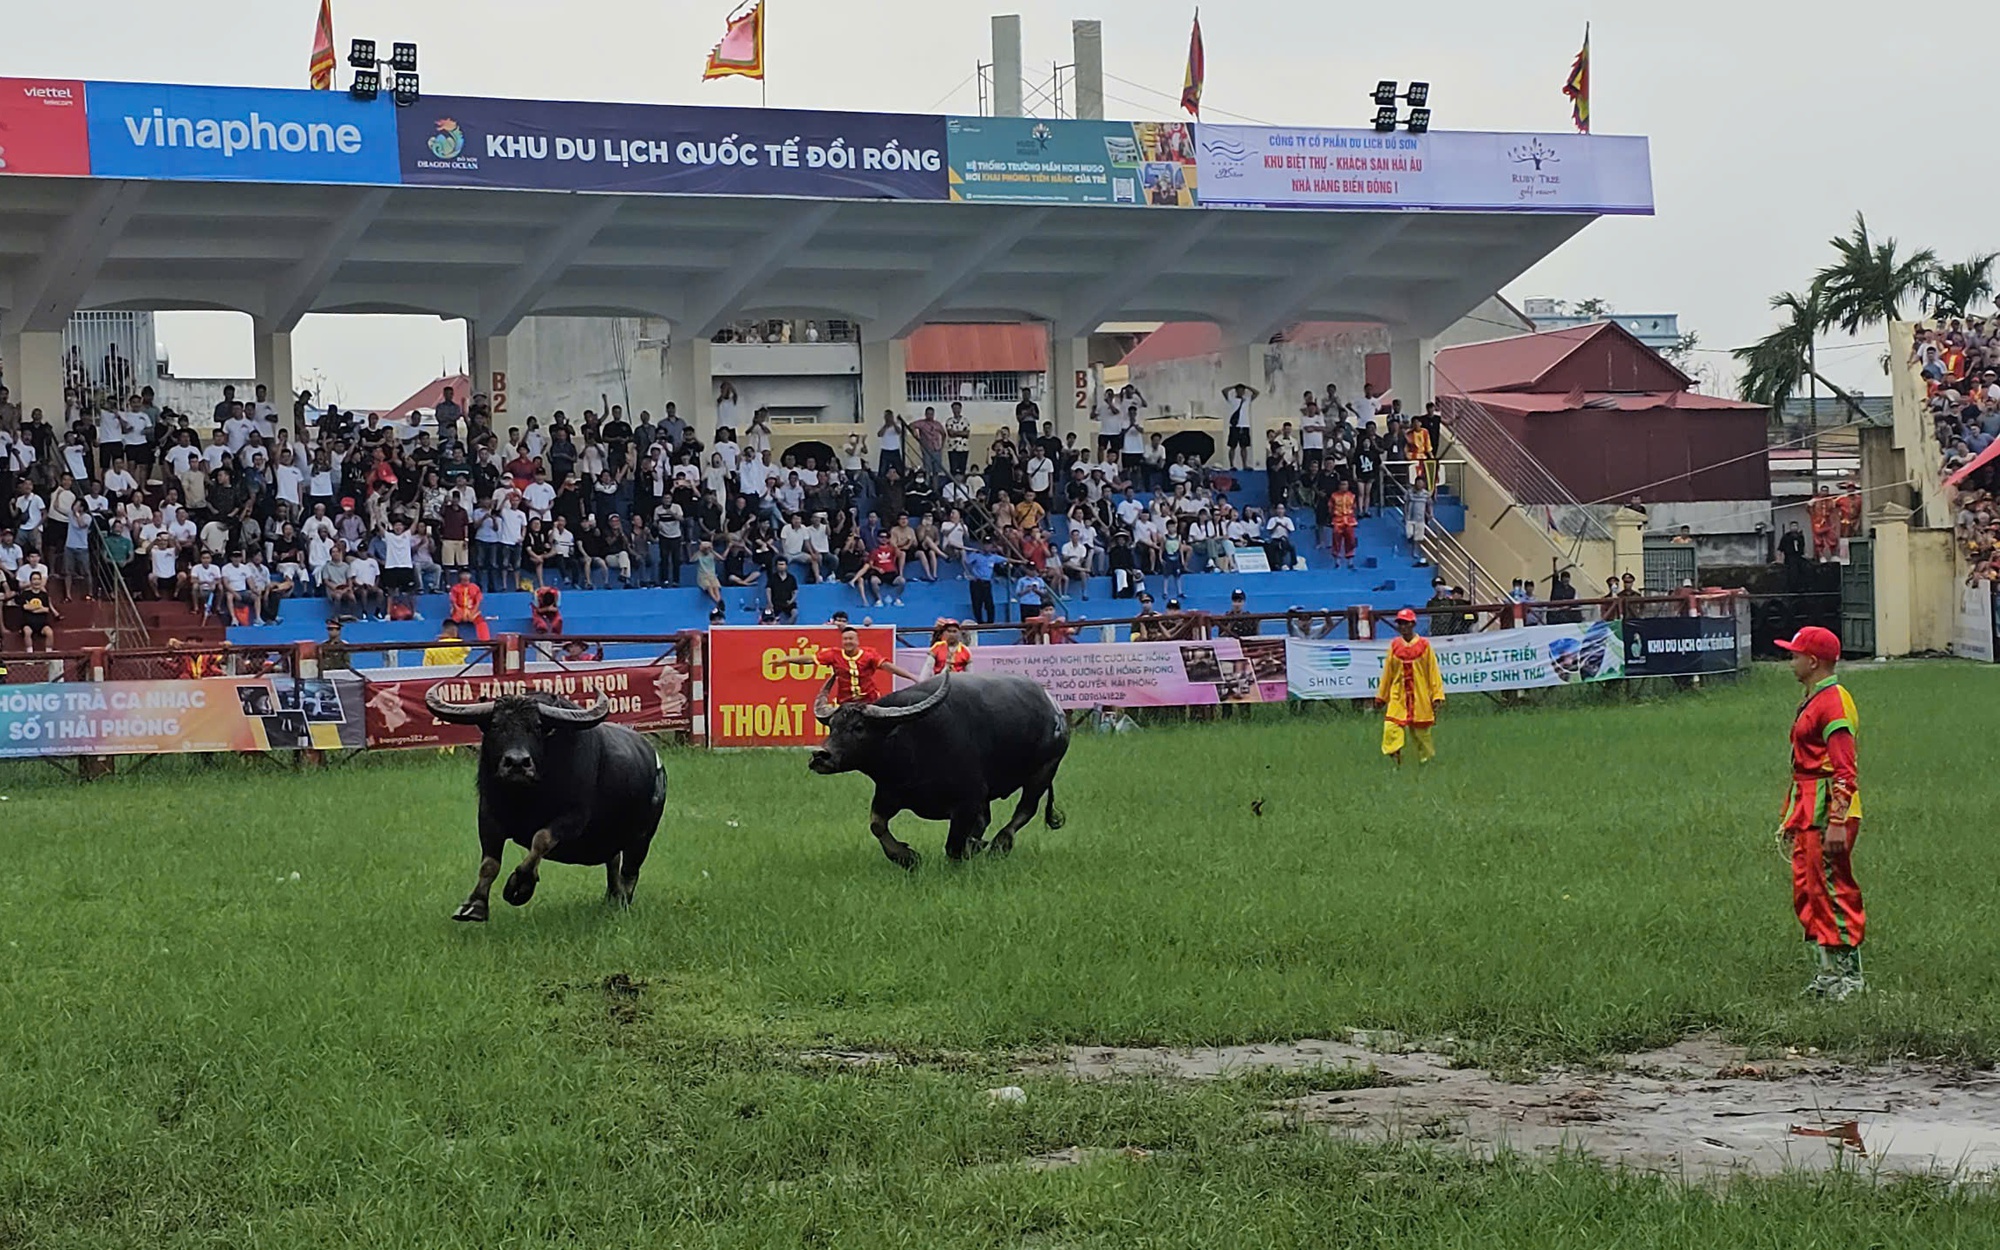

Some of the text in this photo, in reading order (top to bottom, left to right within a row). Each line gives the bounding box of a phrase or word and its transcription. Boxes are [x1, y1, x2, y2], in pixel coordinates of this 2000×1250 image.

[24, 87, 73, 98] viettel
[124, 108, 363, 157] vinaphone
[1269, 135, 1293, 147] CÔNG
[1295, 136, 1306, 147] TY
[1350, 138, 1361, 149] DU
[1363, 138, 1383, 151] LỊCH
[1399, 138, 1418, 150] SƠN
[486, 133, 941, 172] KHU DU LỊCH QUỐC TẾ ĐỒI RỒNG
[417, 160, 450, 169] DRAGON
[1264, 155, 1283, 168] KHU
[1286, 155, 1306, 175] BIỆT
[1309, 155, 1327, 174] THỰ
[1336, 155, 1367, 171] KHÁCH
[1370, 157, 1389, 175] SẠN
[1291, 177, 1311, 193] NHÀ
[1314, 178, 1340, 193] HÀNG
[1512, 174, 1535, 183] RUBY
[1465, 647, 1500, 665] PHÁT
[1502, 642, 1537, 662] TRIỂN
[1648, 639, 1664, 653] KHU
[1665, 639, 1676, 653] DU
[1678, 638, 1695, 655] LỊCH
[992, 657, 1021, 666] TRUNG
[1036, 666, 1049, 678] SỐ
[1441, 669, 1488, 687] NGHIỆP
[1491, 669, 1520, 682] SINH
[438, 673, 628, 702] NHÀ HÀNG TRÂU NGON
[1056, 680, 1076, 689] NGÔ
[1309, 676, 1354, 687] SHINEC
[64, 688, 108, 711] TRÀ
[111, 692, 143, 710] CA
[146, 690, 206, 713] NHẠC
[586, 693, 642, 714] PÒNG
[719, 697, 807, 737] THOÁT
[9, 714, 180, 740] SỐ 1 HẢI PHÒNG
